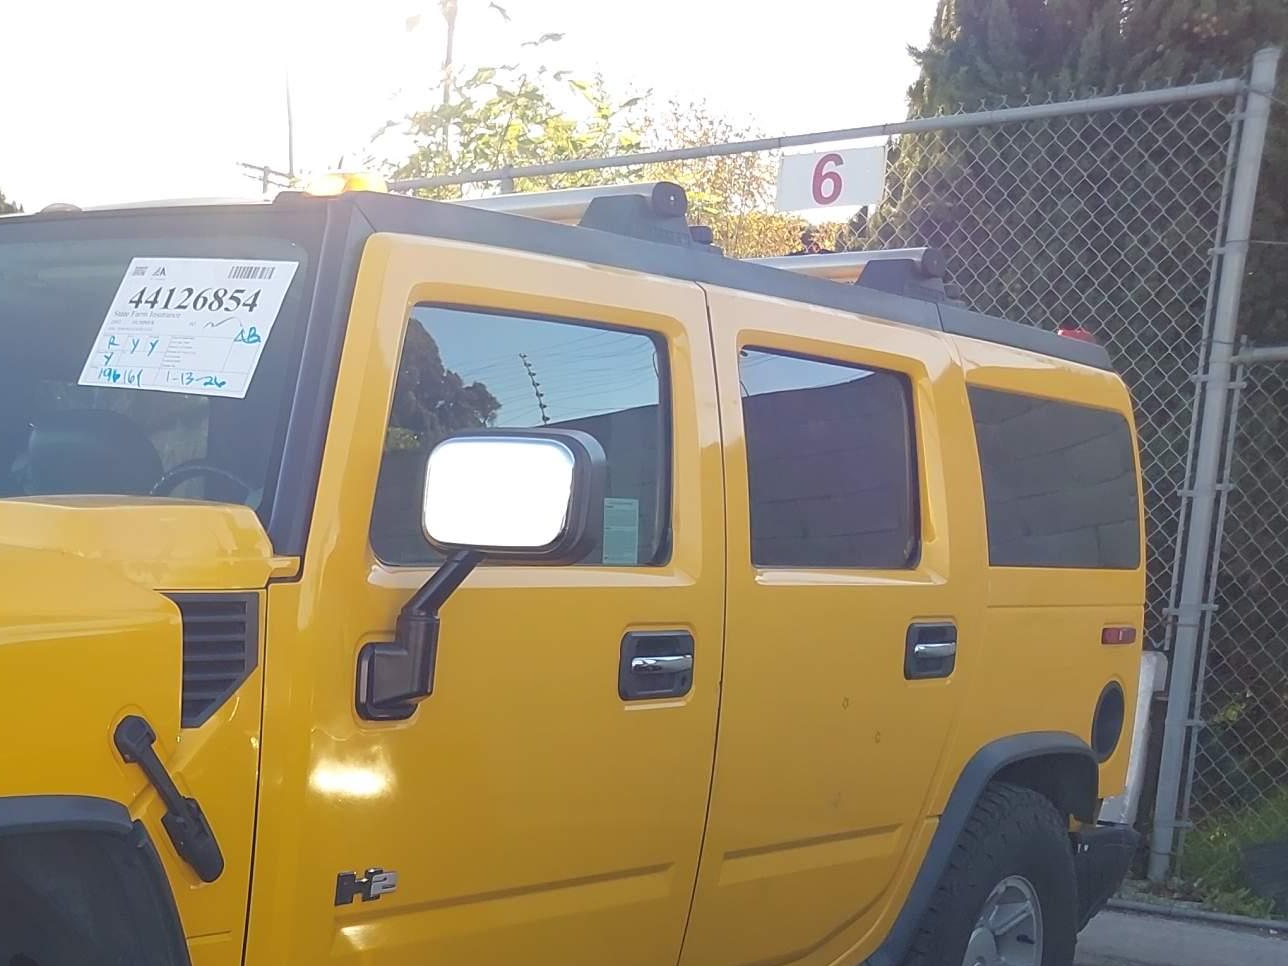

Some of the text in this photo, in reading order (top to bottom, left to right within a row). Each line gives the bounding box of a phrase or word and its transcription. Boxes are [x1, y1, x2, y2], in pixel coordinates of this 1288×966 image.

[812, 153, 844, 206] 6
[129, 286, 262, 313] 44126854
[150, 311, 182, 319] Insurance
[166, 371, 227, 388] 1-13-26
[335, 868, 398, 907] H2
